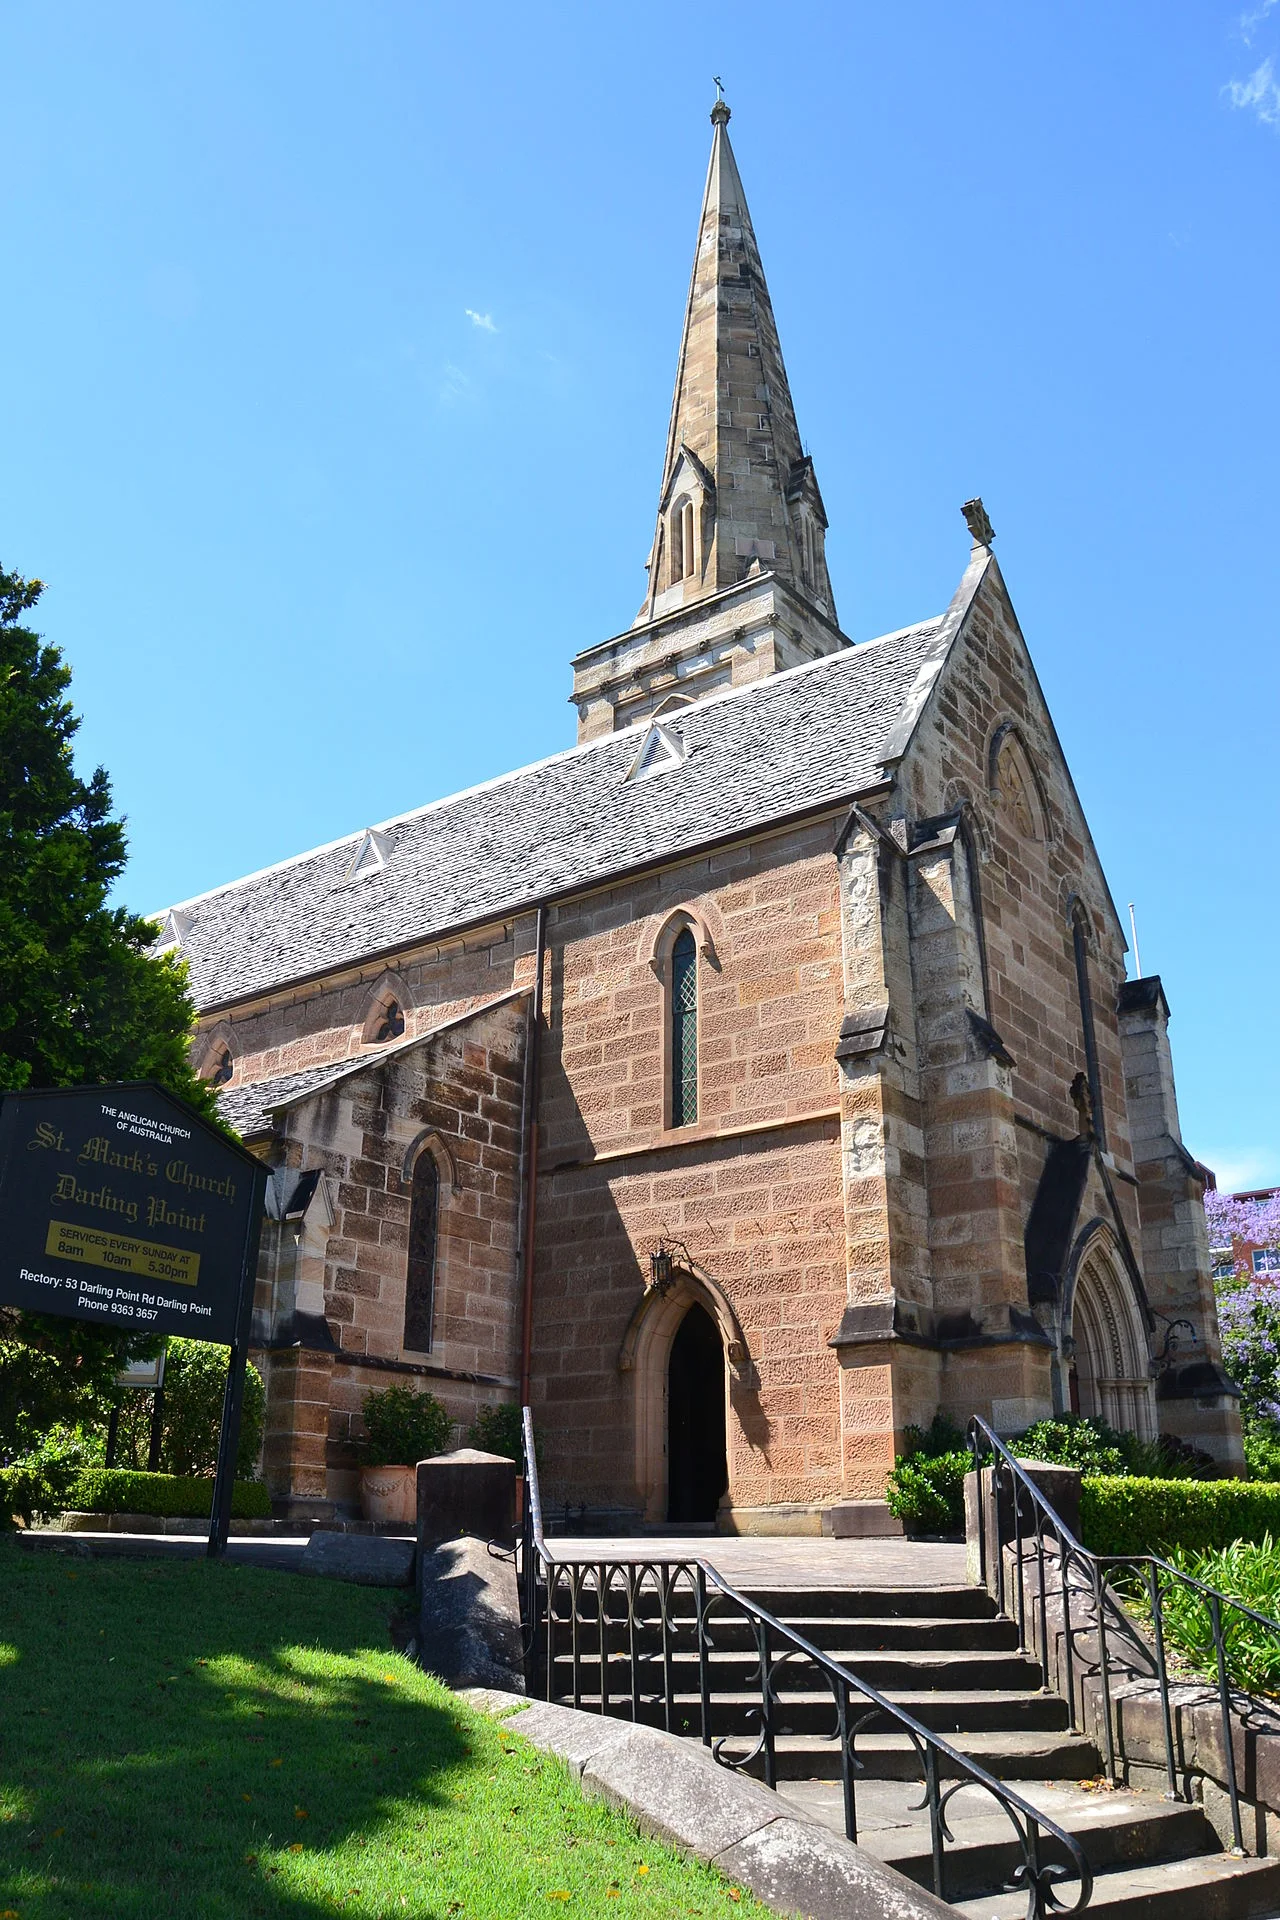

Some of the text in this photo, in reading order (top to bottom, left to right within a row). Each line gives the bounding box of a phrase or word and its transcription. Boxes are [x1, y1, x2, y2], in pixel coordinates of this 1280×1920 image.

[101, 1105, 191, 1139] THE ANGLICAN CHURCH
[116, 1121, 172, 1144] OF AUSTRALIA
[27, 1121, 236, 1204] St. Mark's Church
[50, 1171, 206, 1232] Darling Point
[58, 1241, 188, 1279] 8am 10am 5.30pm
[60, 1228, 191, 1265] SERVICES EVERY SUNDAY AT
[19, 1269, 212, 1316] Rectory: 53 Darling Point Rd Darling Point
[77, 1296, 158, 1320] Phone 9363 3657
